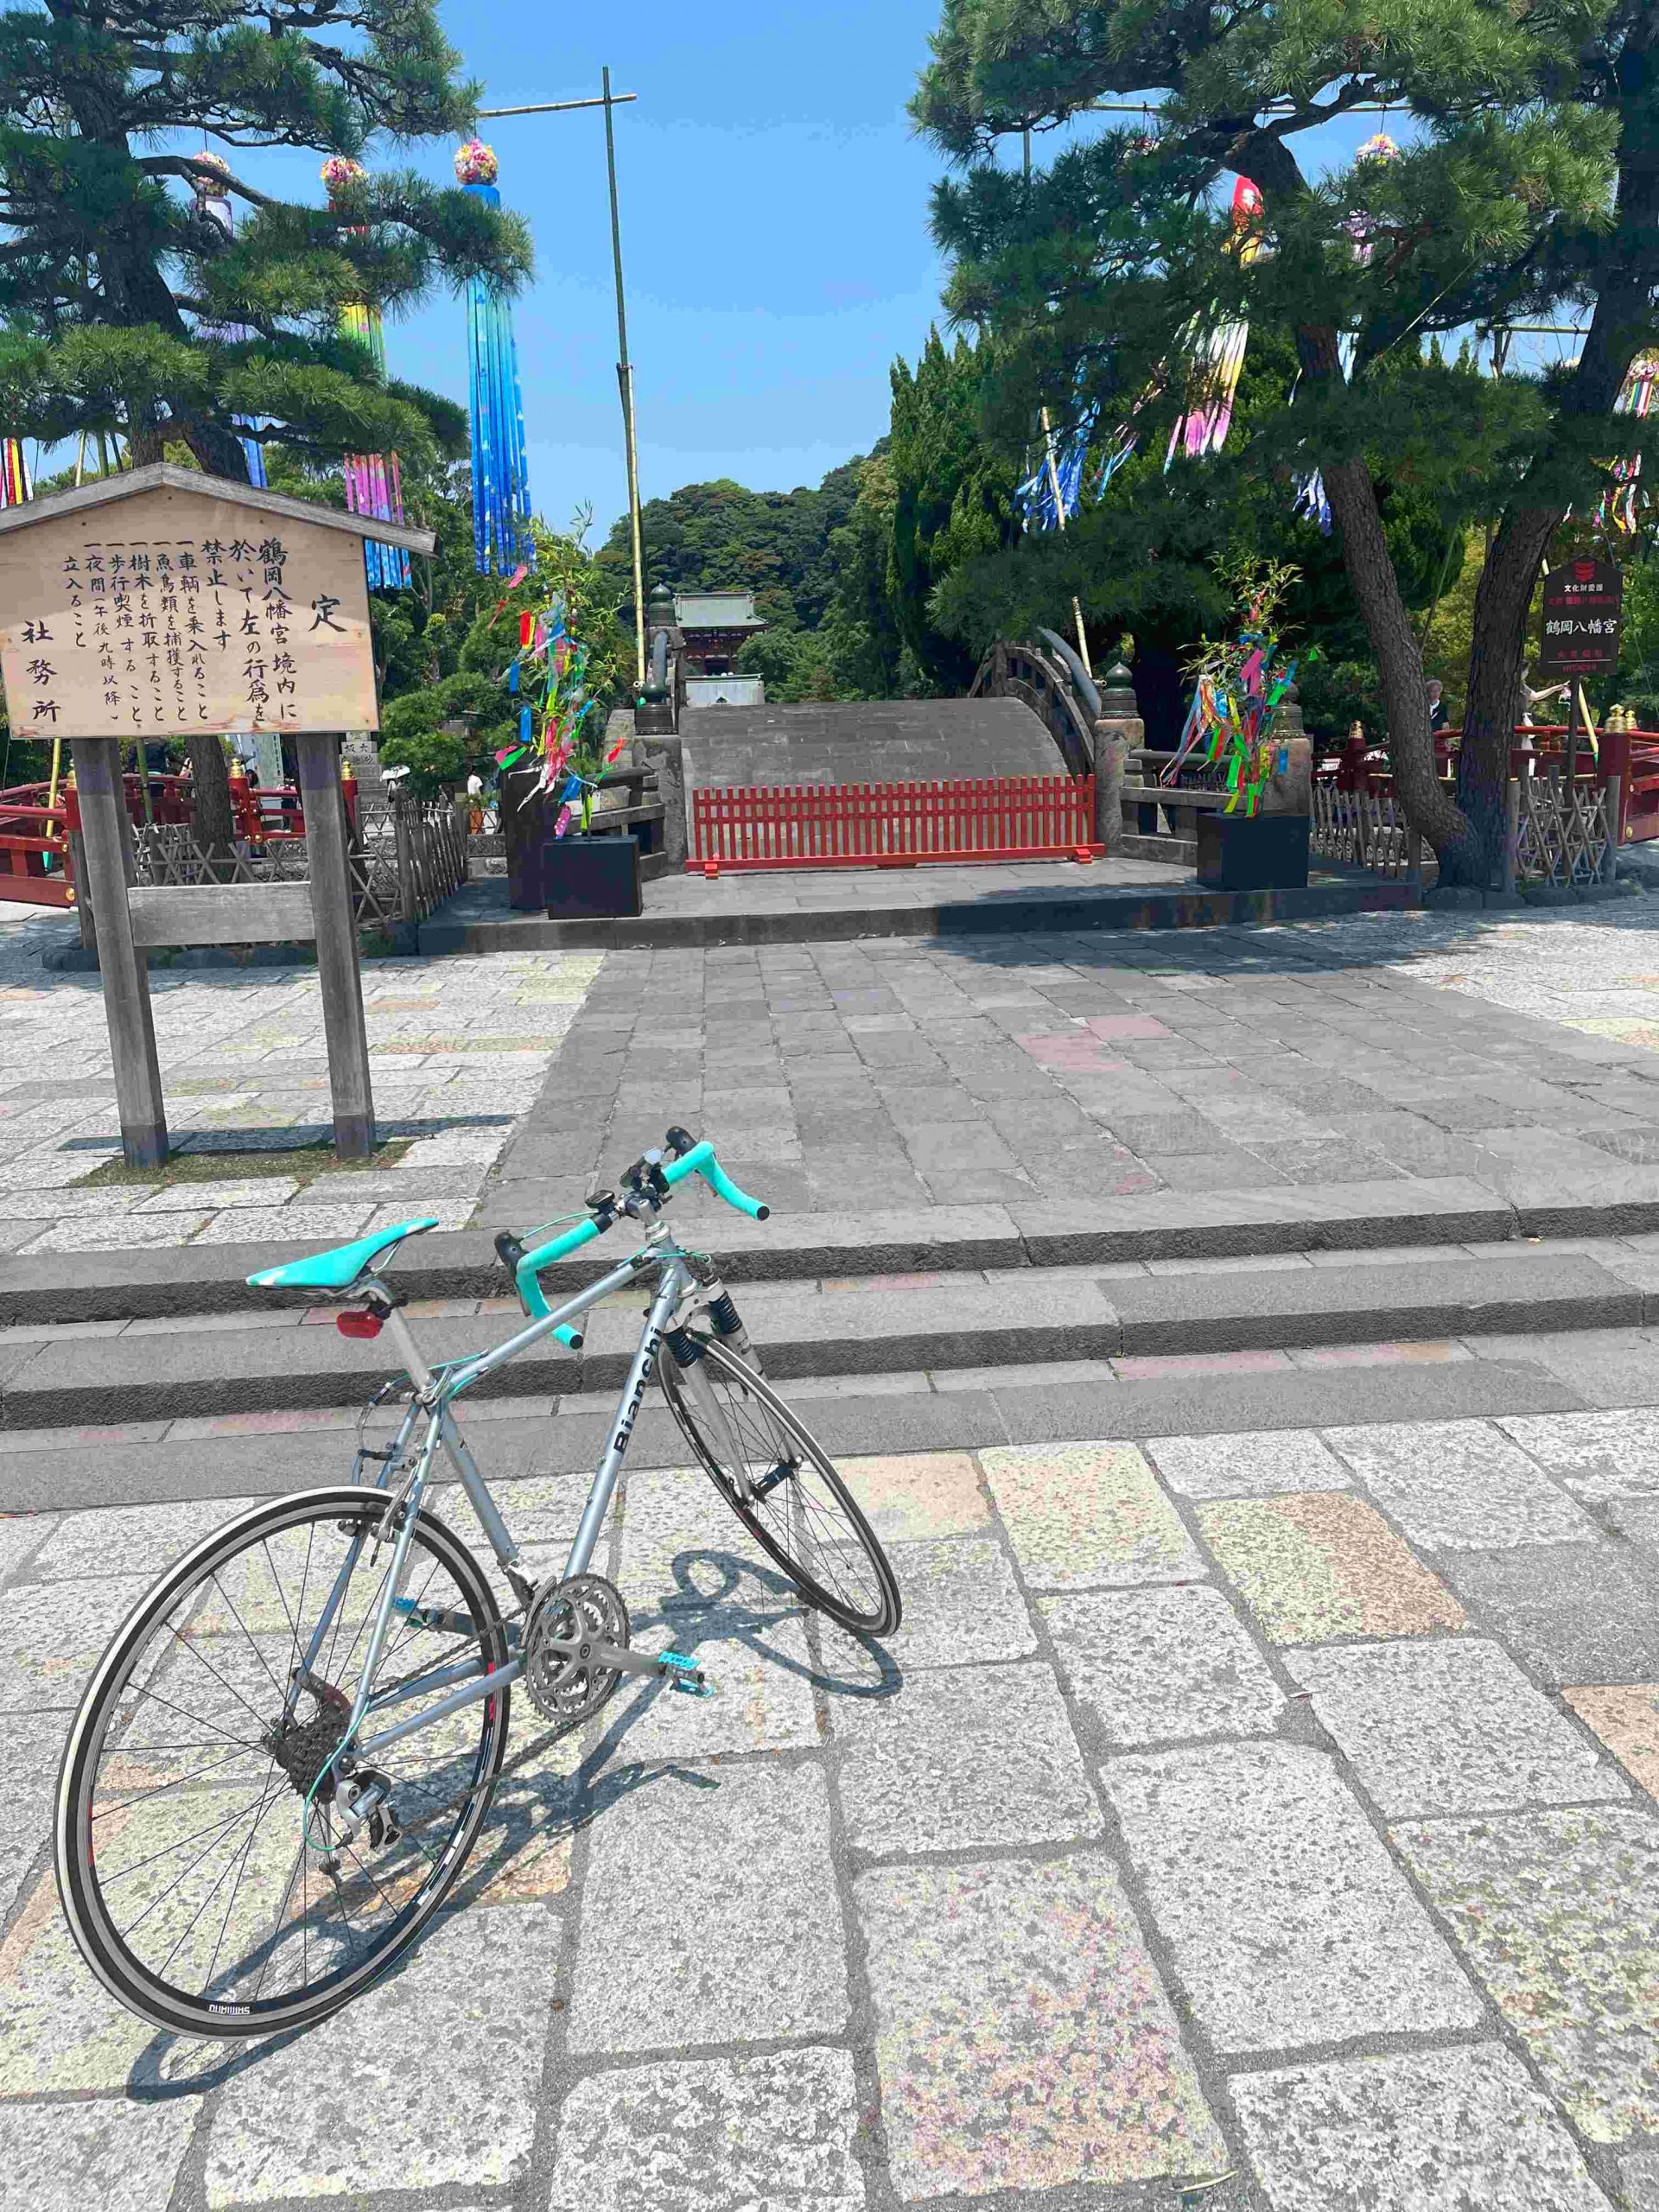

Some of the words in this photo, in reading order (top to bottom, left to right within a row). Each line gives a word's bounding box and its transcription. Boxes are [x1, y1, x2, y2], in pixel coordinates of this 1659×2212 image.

[63, 555, 86, 647] 立入ること
[200, 538, 232, 651] 禁止します
[256, 537, 297, 720] 鶴岡八幡宮境内に
[308, 594, 348, 632] 定
[1546, 619, 1618, 636] 鶴岡八幡宮
[21, 620, 61, 722] 社務所
[613, 1327, 662, 1454] Bianchi
[208, 2004, 251, 2015] SHIMANO
